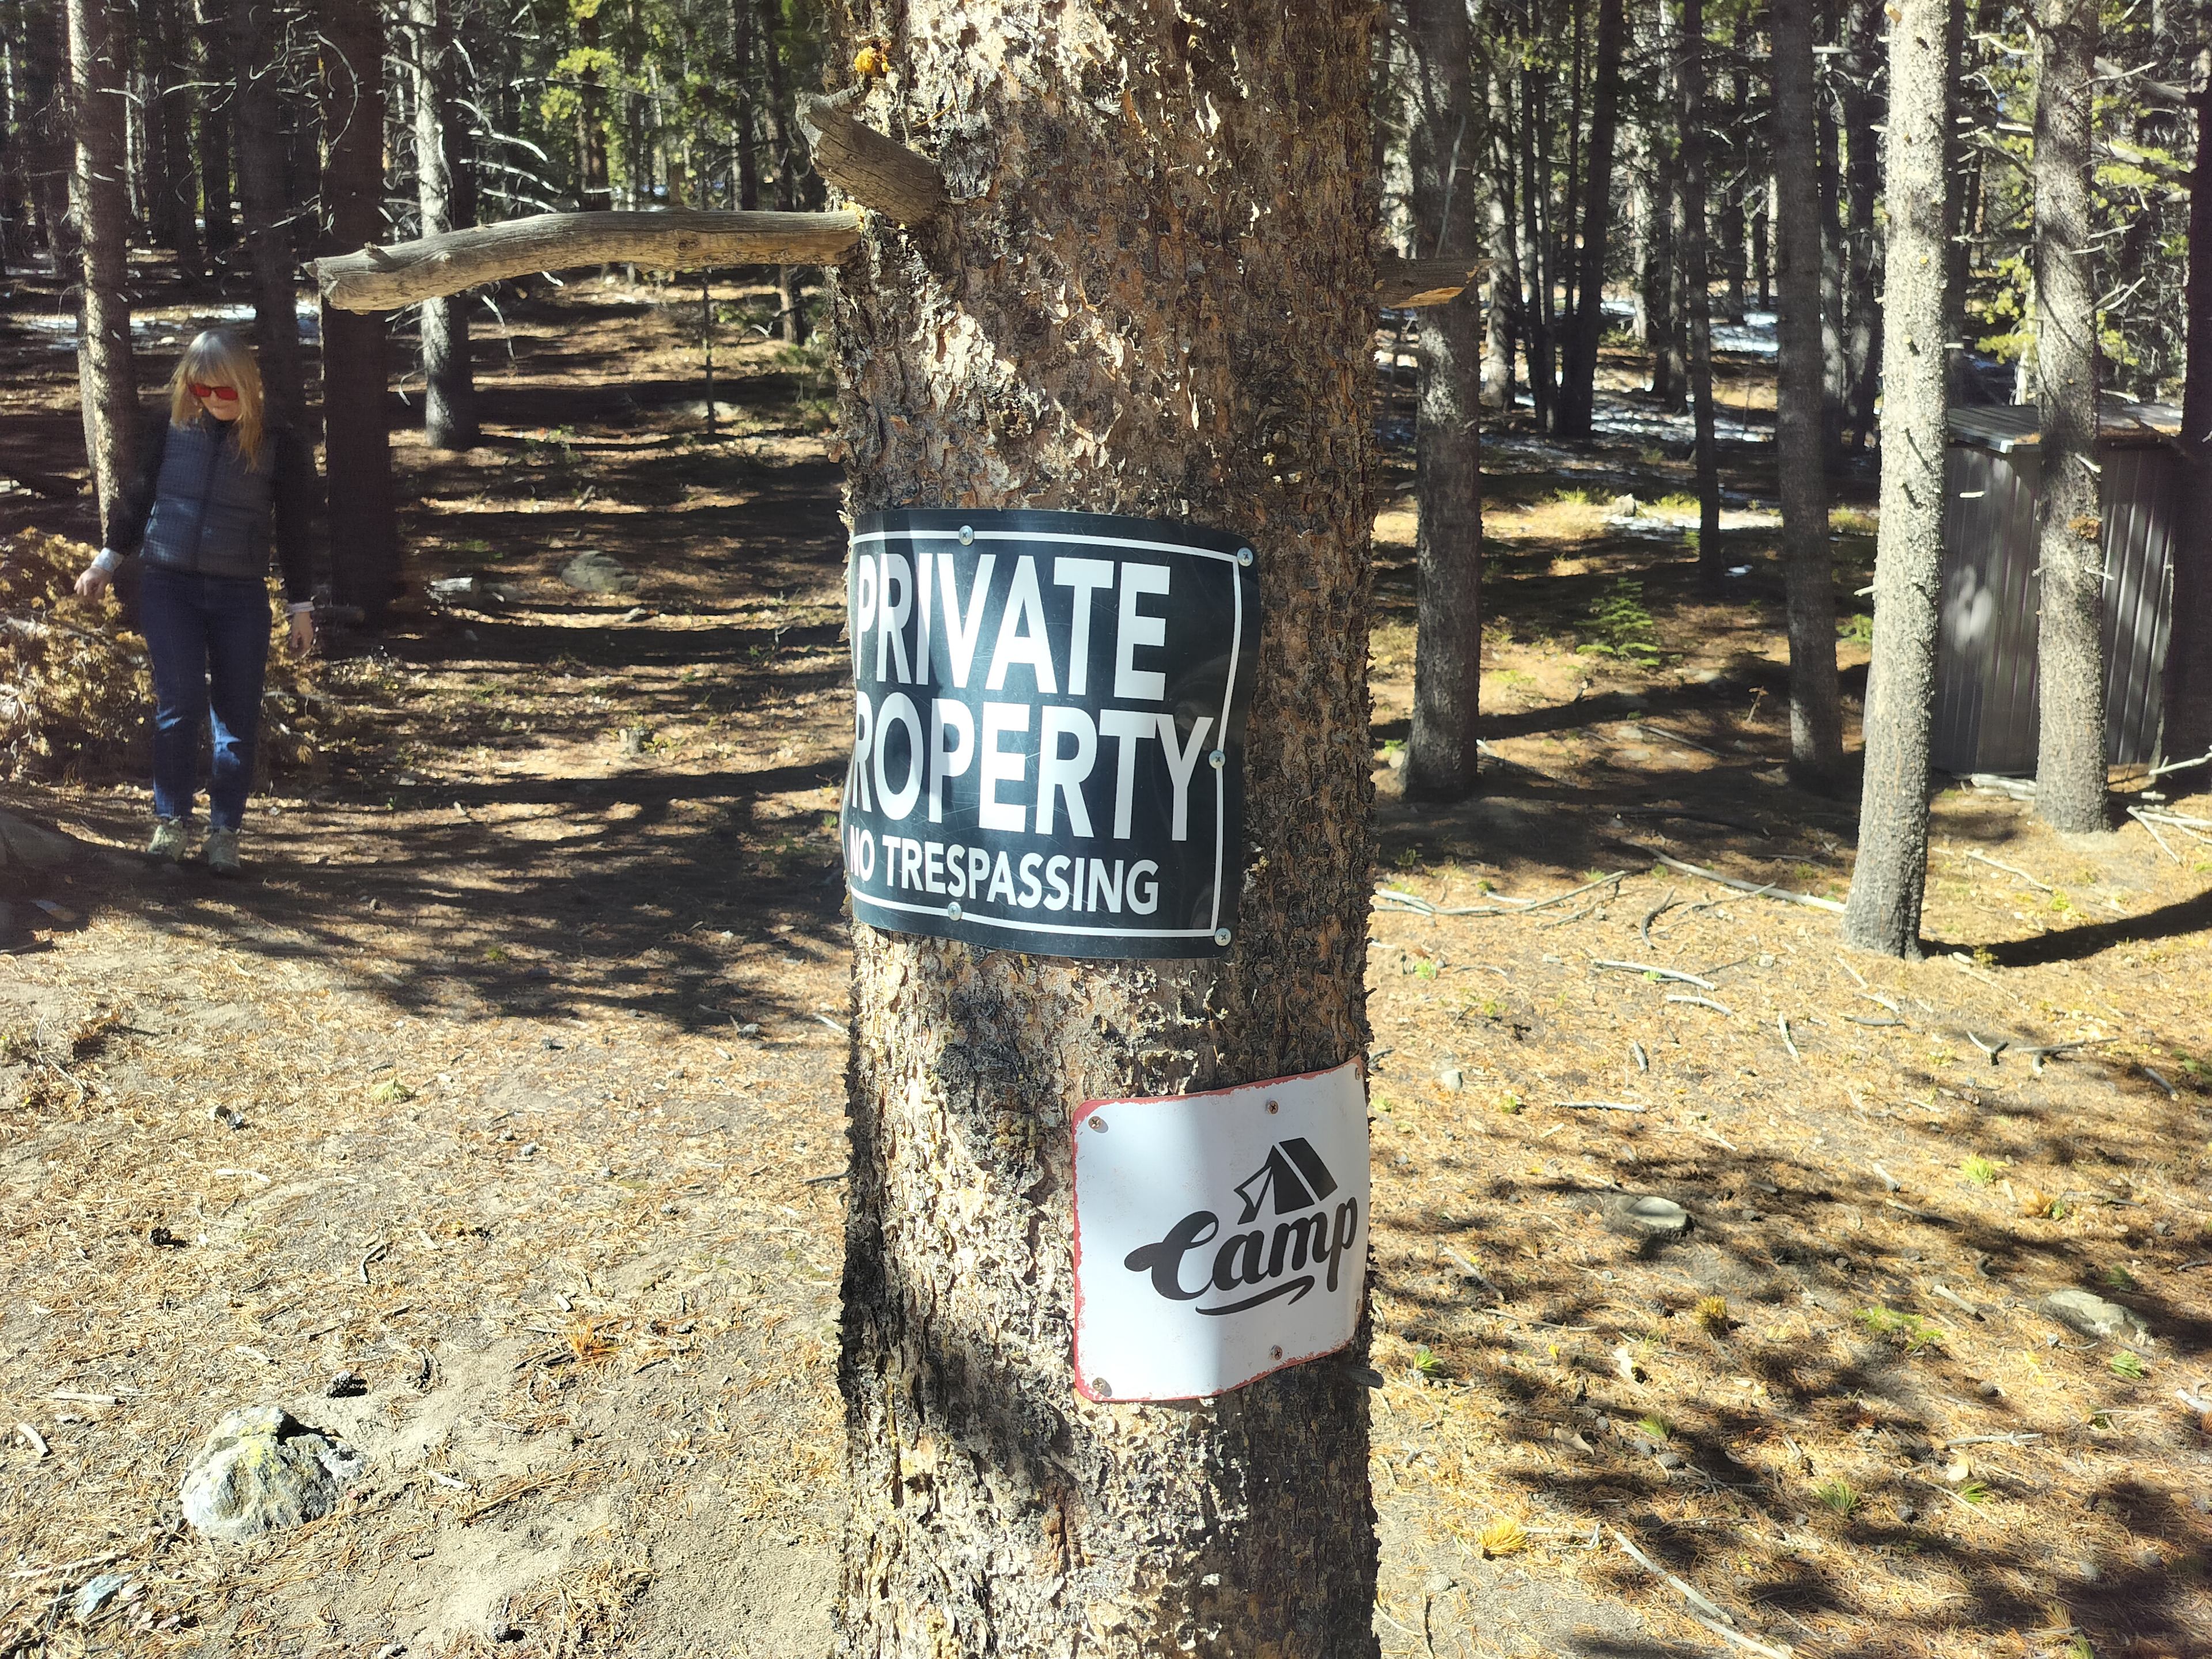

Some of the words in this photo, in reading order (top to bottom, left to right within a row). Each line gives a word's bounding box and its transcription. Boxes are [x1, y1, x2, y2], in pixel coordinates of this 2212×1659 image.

[856, 552, 1171, 701] PRIVATE
[852, 691, 1214, 842] ROPERTY
[850, 824, 875, 882] NO
[881, 834, 1160, 915] TRESPASSING
[1124, 1196, 1358, 1301] Camp
